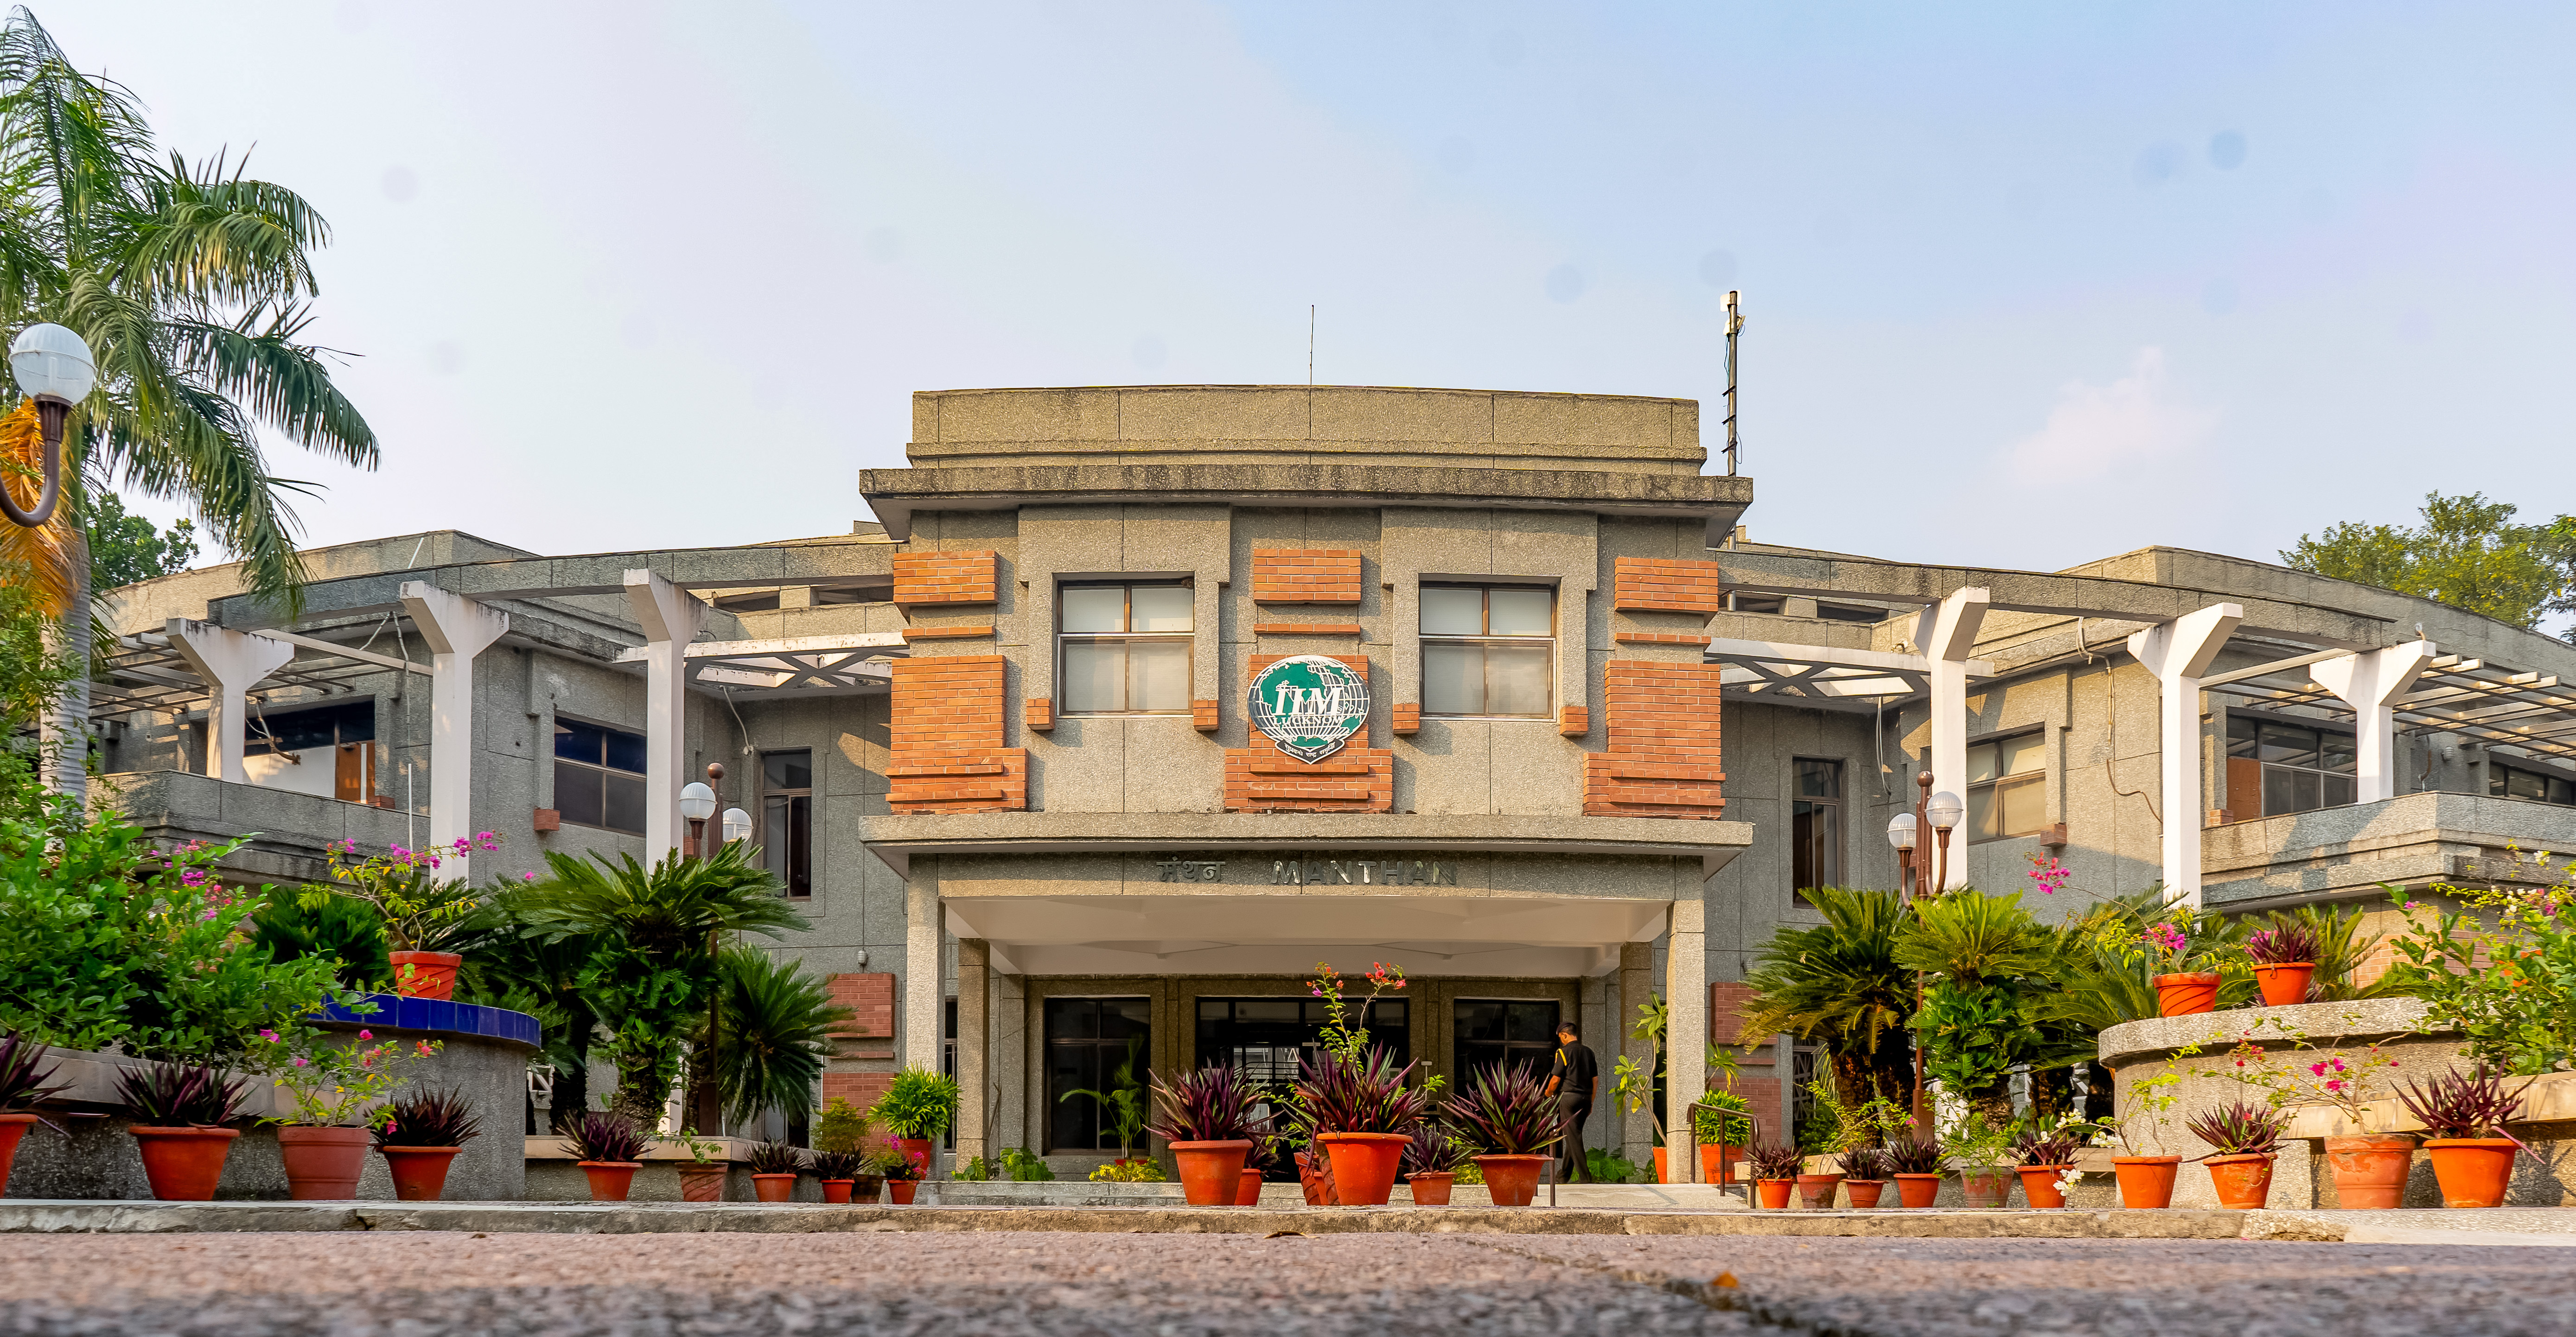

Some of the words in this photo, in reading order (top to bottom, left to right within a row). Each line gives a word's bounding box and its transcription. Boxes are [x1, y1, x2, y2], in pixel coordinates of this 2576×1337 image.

[1272, 687, 1343, 715] IIM
[1273, 716, 1346, 725] LUCKNOW
[1156, 856, 1225, 881] मंथन
[1271, 860, 1456, 884] MANTHAN
